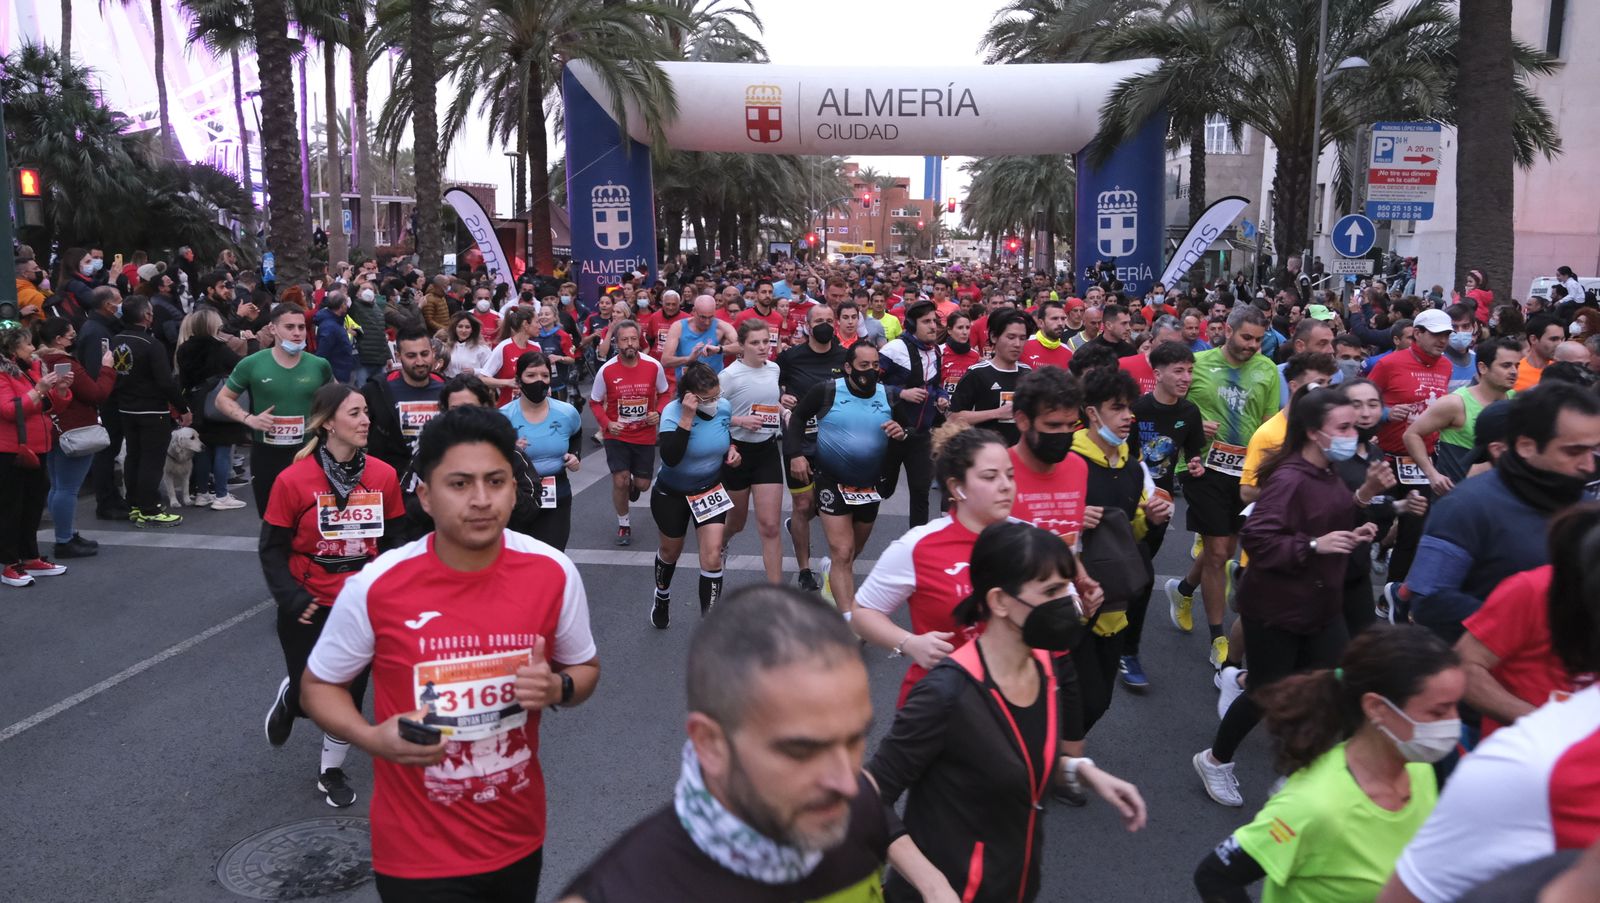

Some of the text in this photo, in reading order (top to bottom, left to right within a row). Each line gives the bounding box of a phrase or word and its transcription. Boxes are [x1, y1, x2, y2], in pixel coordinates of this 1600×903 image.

[816, 82, 980, 117] ALMERÍA
[816, 123, 899, 140] CIUDAD
[1376, 138, 1393, 157] P
[596, 275, 622, 285] CIUD
[624, 406, 644, 414] 240
[410, 414, 432, 424] 320
[759, 414, 777, 424] 595
[270, 425, 299, 435] 3279
[1216, 452, 1245, 465] 387
[1405, 465, 1420, 475] 51
[699, 492, 723, 509] 186
[331, 508, 373, 522] 3463
[440, 682, 516, 712] 3168
